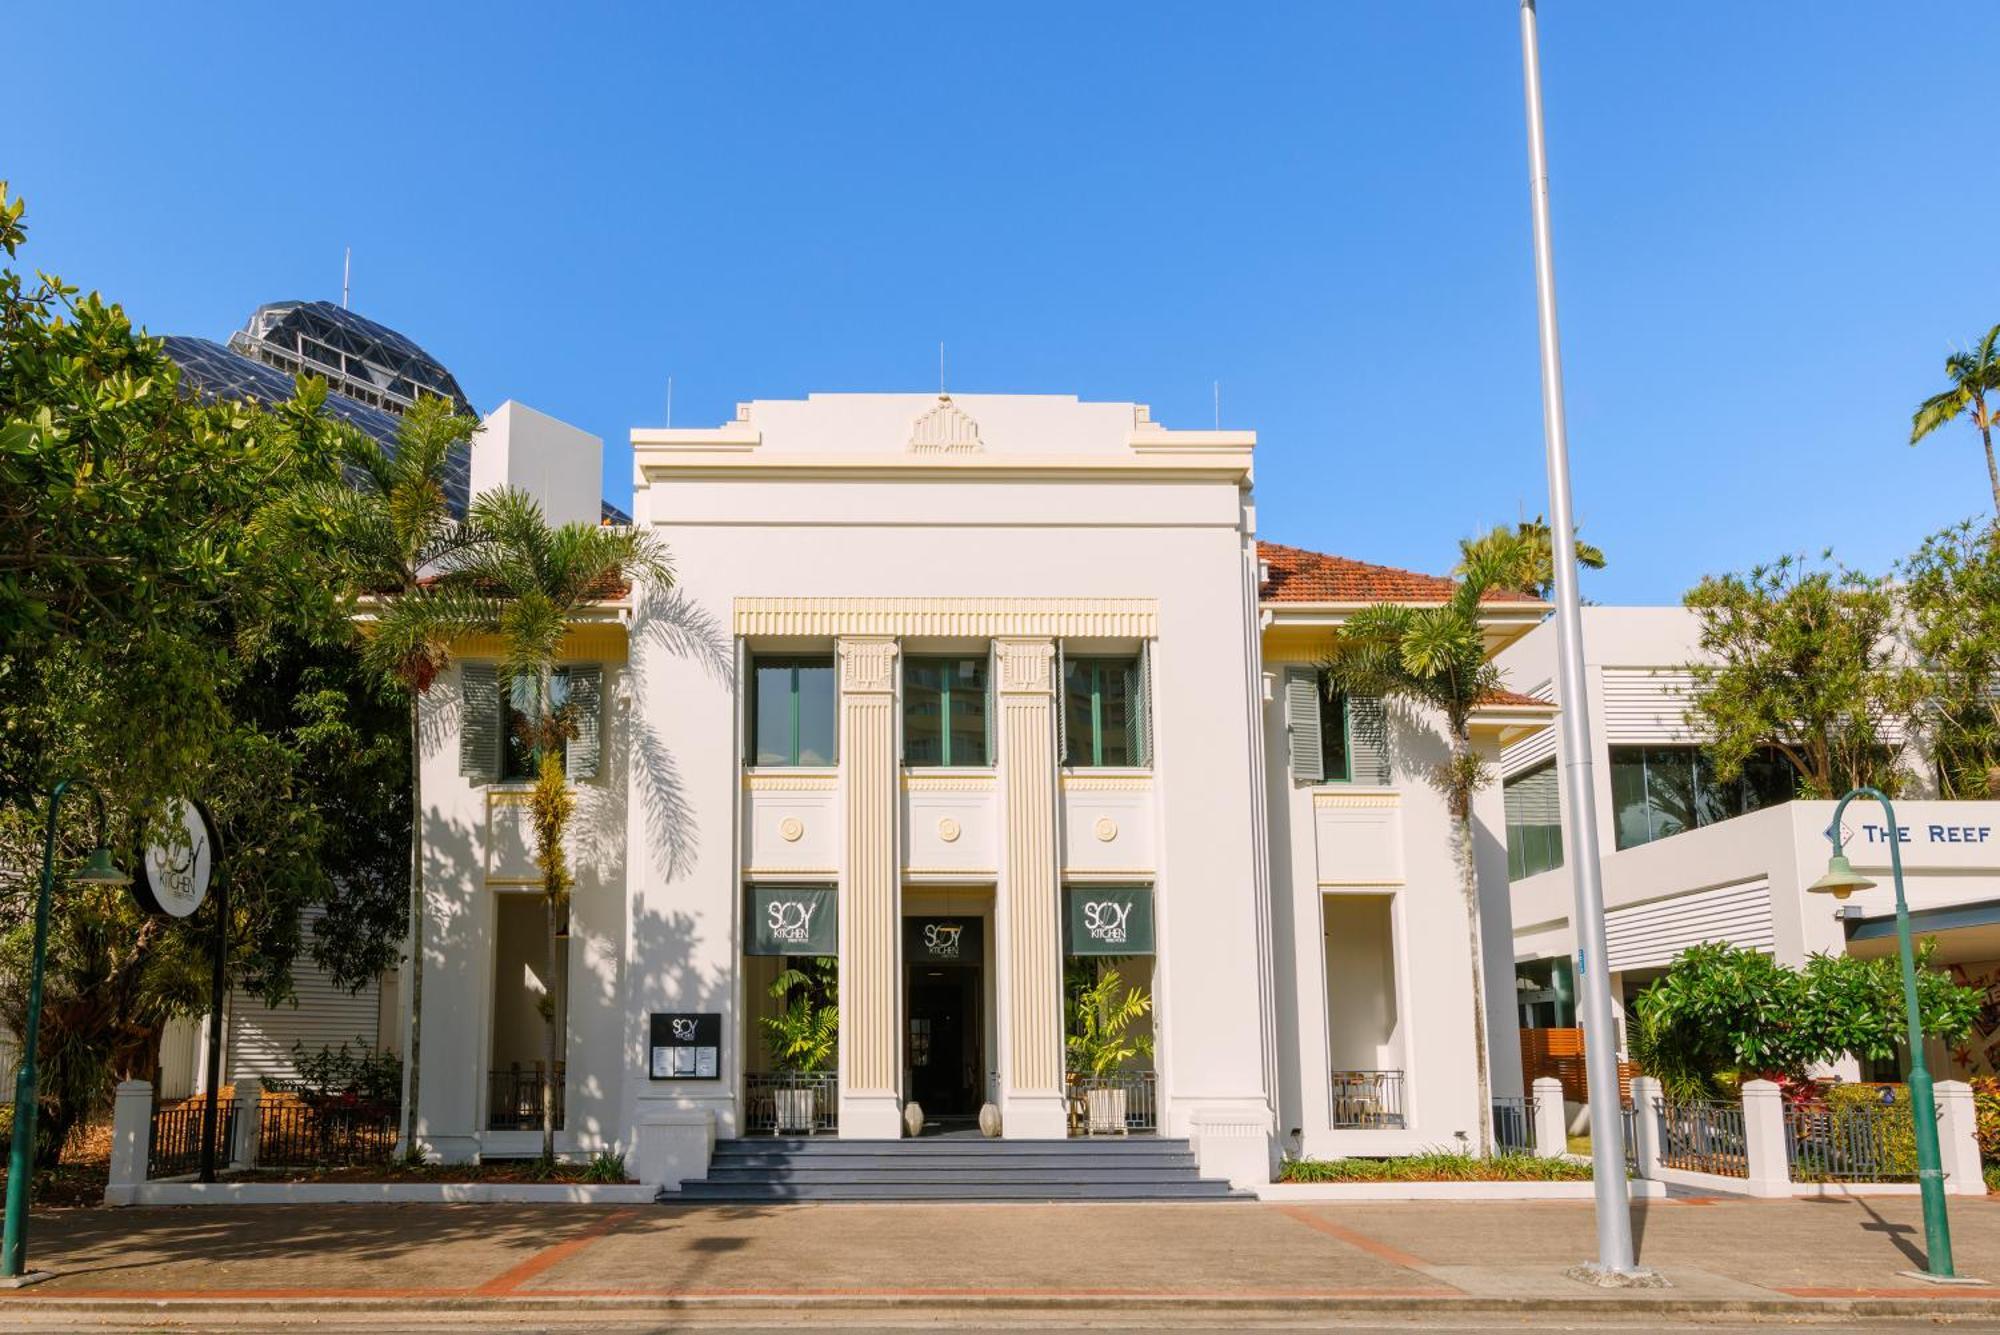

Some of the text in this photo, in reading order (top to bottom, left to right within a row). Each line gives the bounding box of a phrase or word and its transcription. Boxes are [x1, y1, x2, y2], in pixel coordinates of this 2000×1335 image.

[1928, 824, 1992, 843] REEF
[768, 901, 817, 929] SOY
[1084, 901, 1133, 929] SOY
[924, 924, 963, 947] SOY
[672, 1018, 699, 1034] SOY
